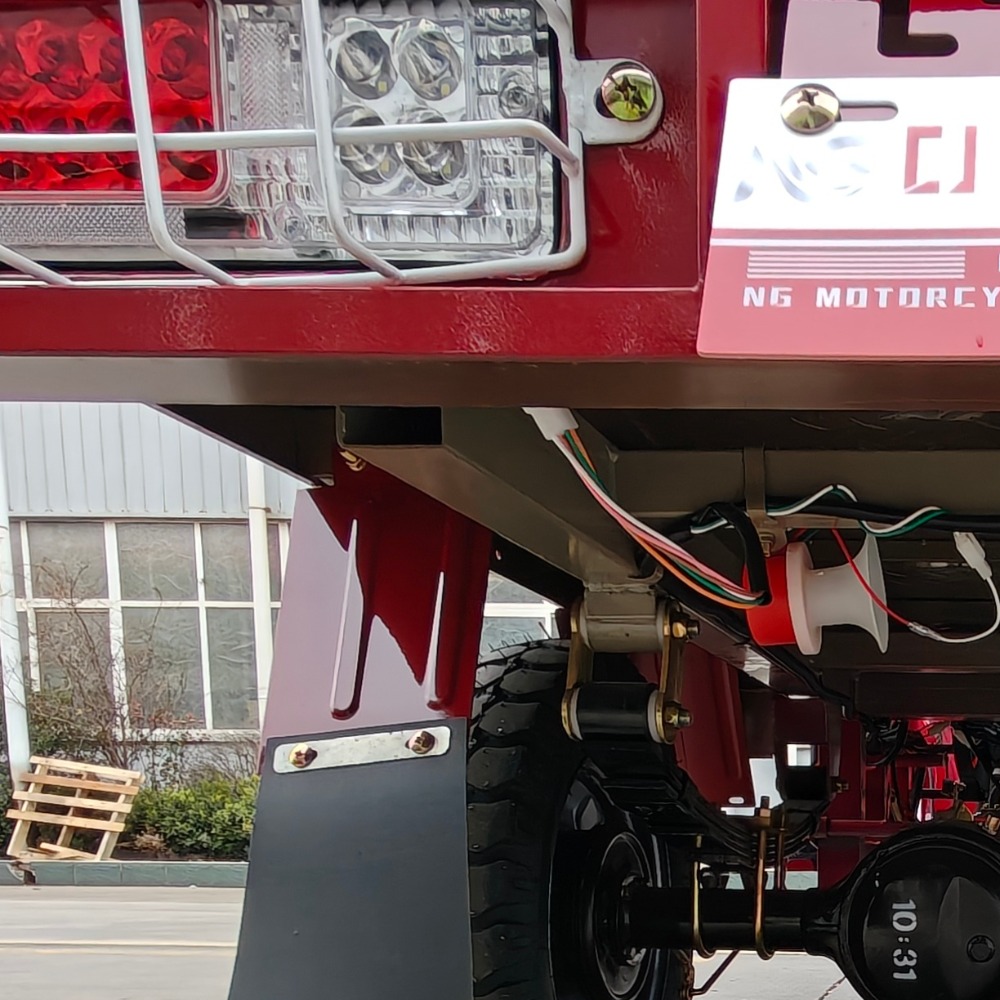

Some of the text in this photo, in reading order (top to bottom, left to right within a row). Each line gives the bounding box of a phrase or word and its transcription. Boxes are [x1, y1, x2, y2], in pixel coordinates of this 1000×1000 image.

[904, 126, 978, 194] CJ
[743, 286, 792, 307] NG
[892, 899, 918, 981] 10:31
